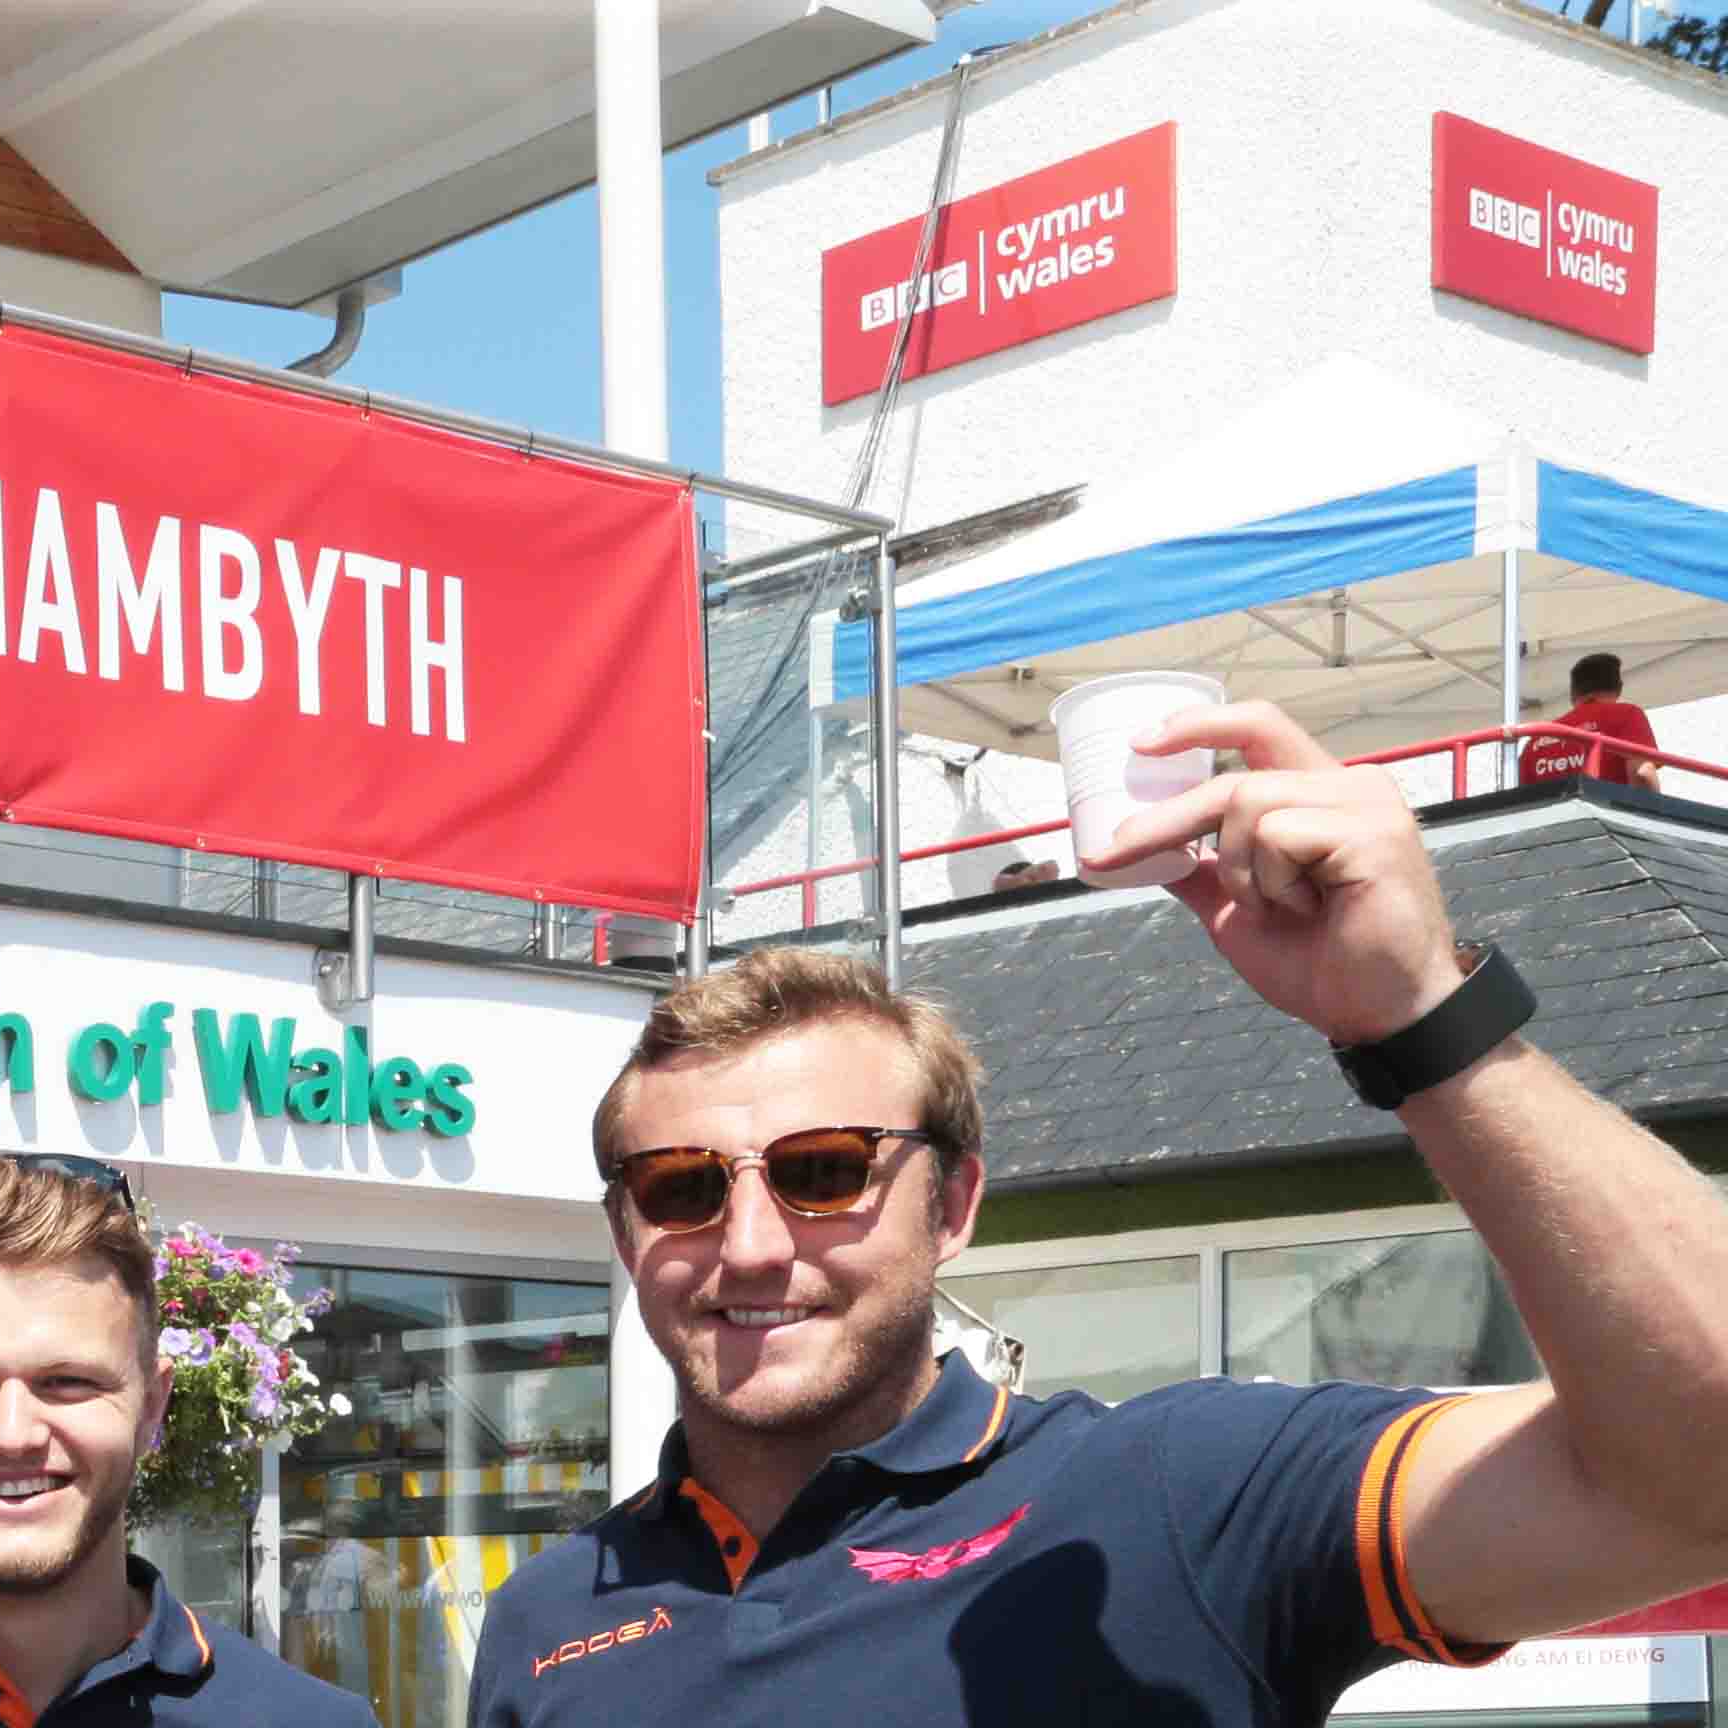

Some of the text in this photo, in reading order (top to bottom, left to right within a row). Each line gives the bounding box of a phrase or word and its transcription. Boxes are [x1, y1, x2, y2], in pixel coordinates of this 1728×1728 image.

[996, 186, 1125, 261] cymru
[1469, 188, 1541, 249] BBC
[1557, 202, 1633, 253] cymru
[997, 235, 1115, 300] wales
[1558, 246, 1628, 296] wales
[67, 1001, 175, 1106] of
[192, 1008, 476, 1138] Wales
